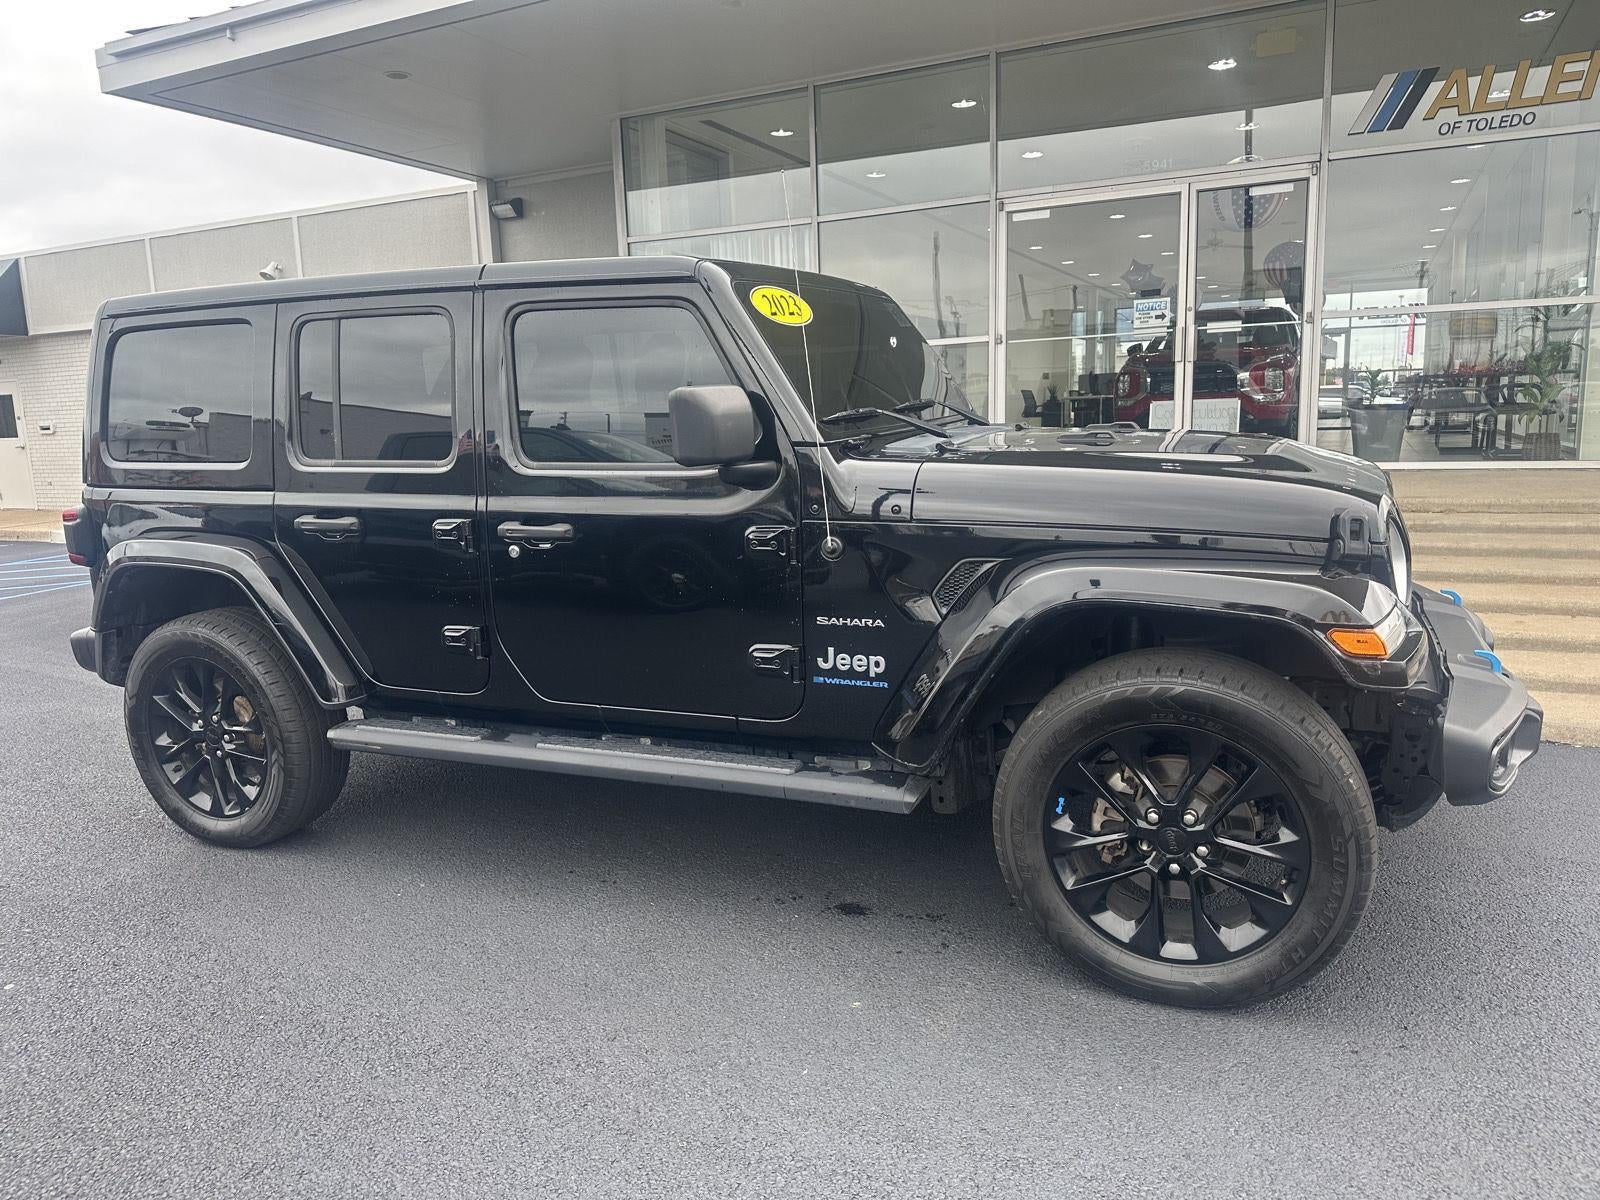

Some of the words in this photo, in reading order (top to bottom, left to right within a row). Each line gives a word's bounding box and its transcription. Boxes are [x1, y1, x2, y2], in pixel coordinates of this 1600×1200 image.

[1438, 121, 1458, 136] OF
[1466, 111, 1536, 133] TOLEDO
[761, 293, 803, 317] 2023
[1137, 301, 1167, 312] NOTICE
[816, 616, 885, 628] SAHARA
[816, 646, 886, 678] Jeep
[824, 677, 889, 689] WRANGLER
